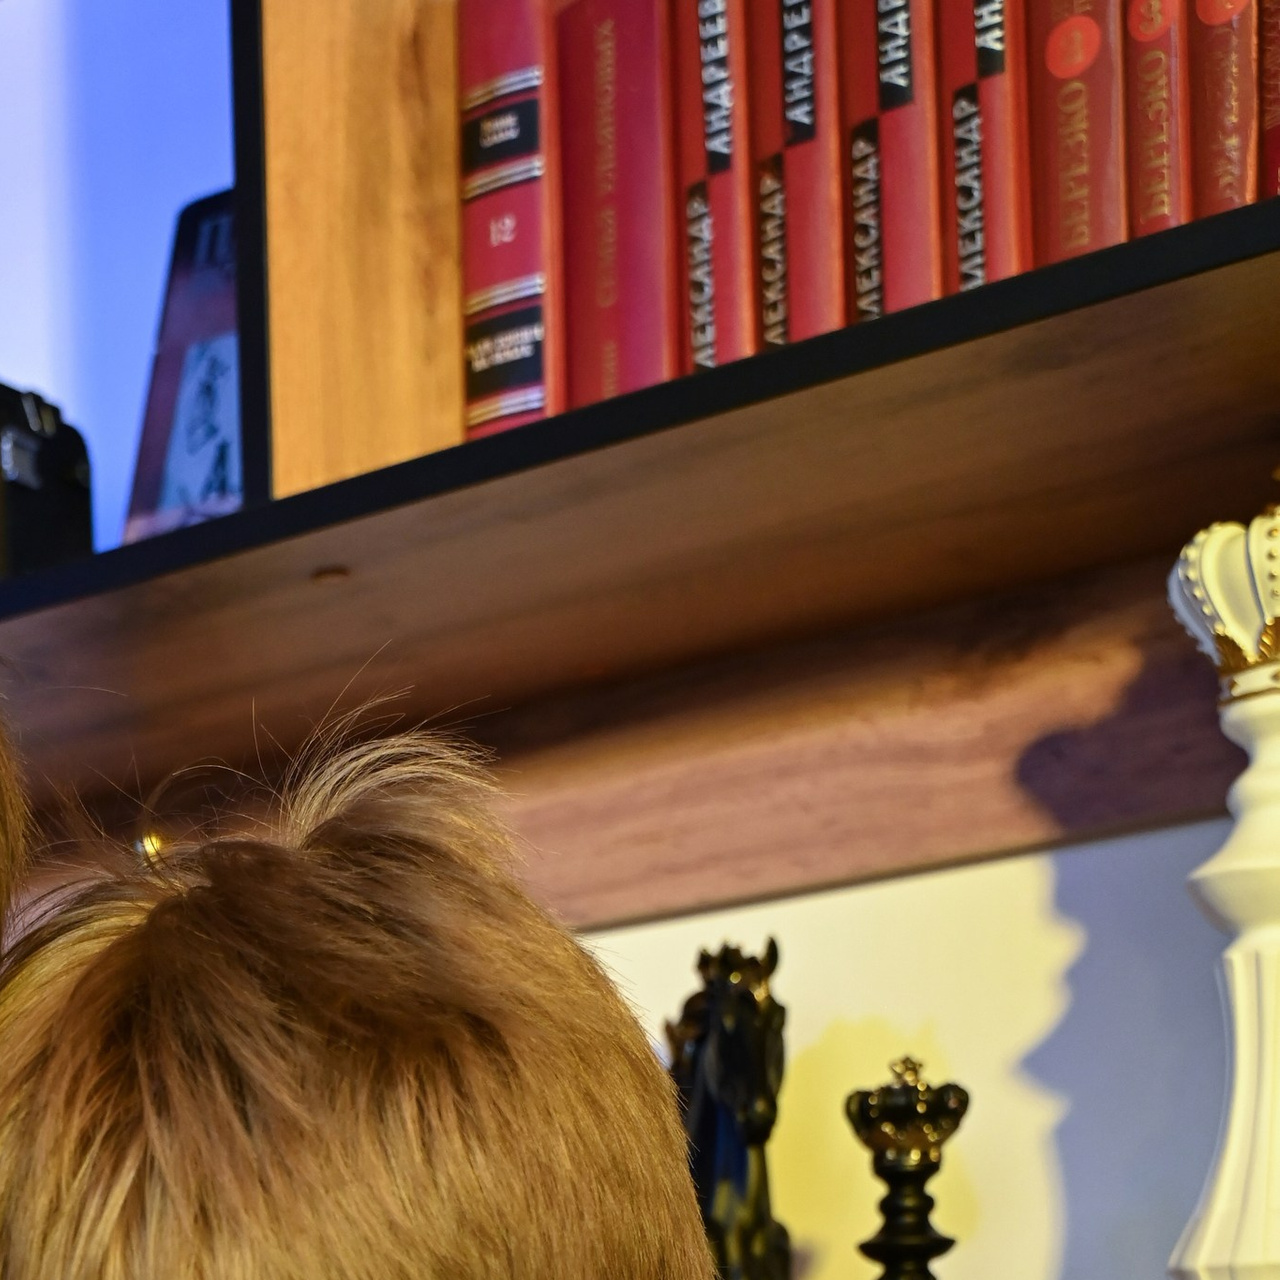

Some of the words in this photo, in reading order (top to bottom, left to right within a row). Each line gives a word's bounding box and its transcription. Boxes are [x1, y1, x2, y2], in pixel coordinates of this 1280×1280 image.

[975, 0, 1004, 51] АН
[760, 171, 787, 345] ЛЕКСАНДР
[783, 0, 814, 126] АНДРЕ
[852, 137, 881, 321] ЛЕКСАНДР
[687, 193, 717, 369] ЛЕКСАНДР
